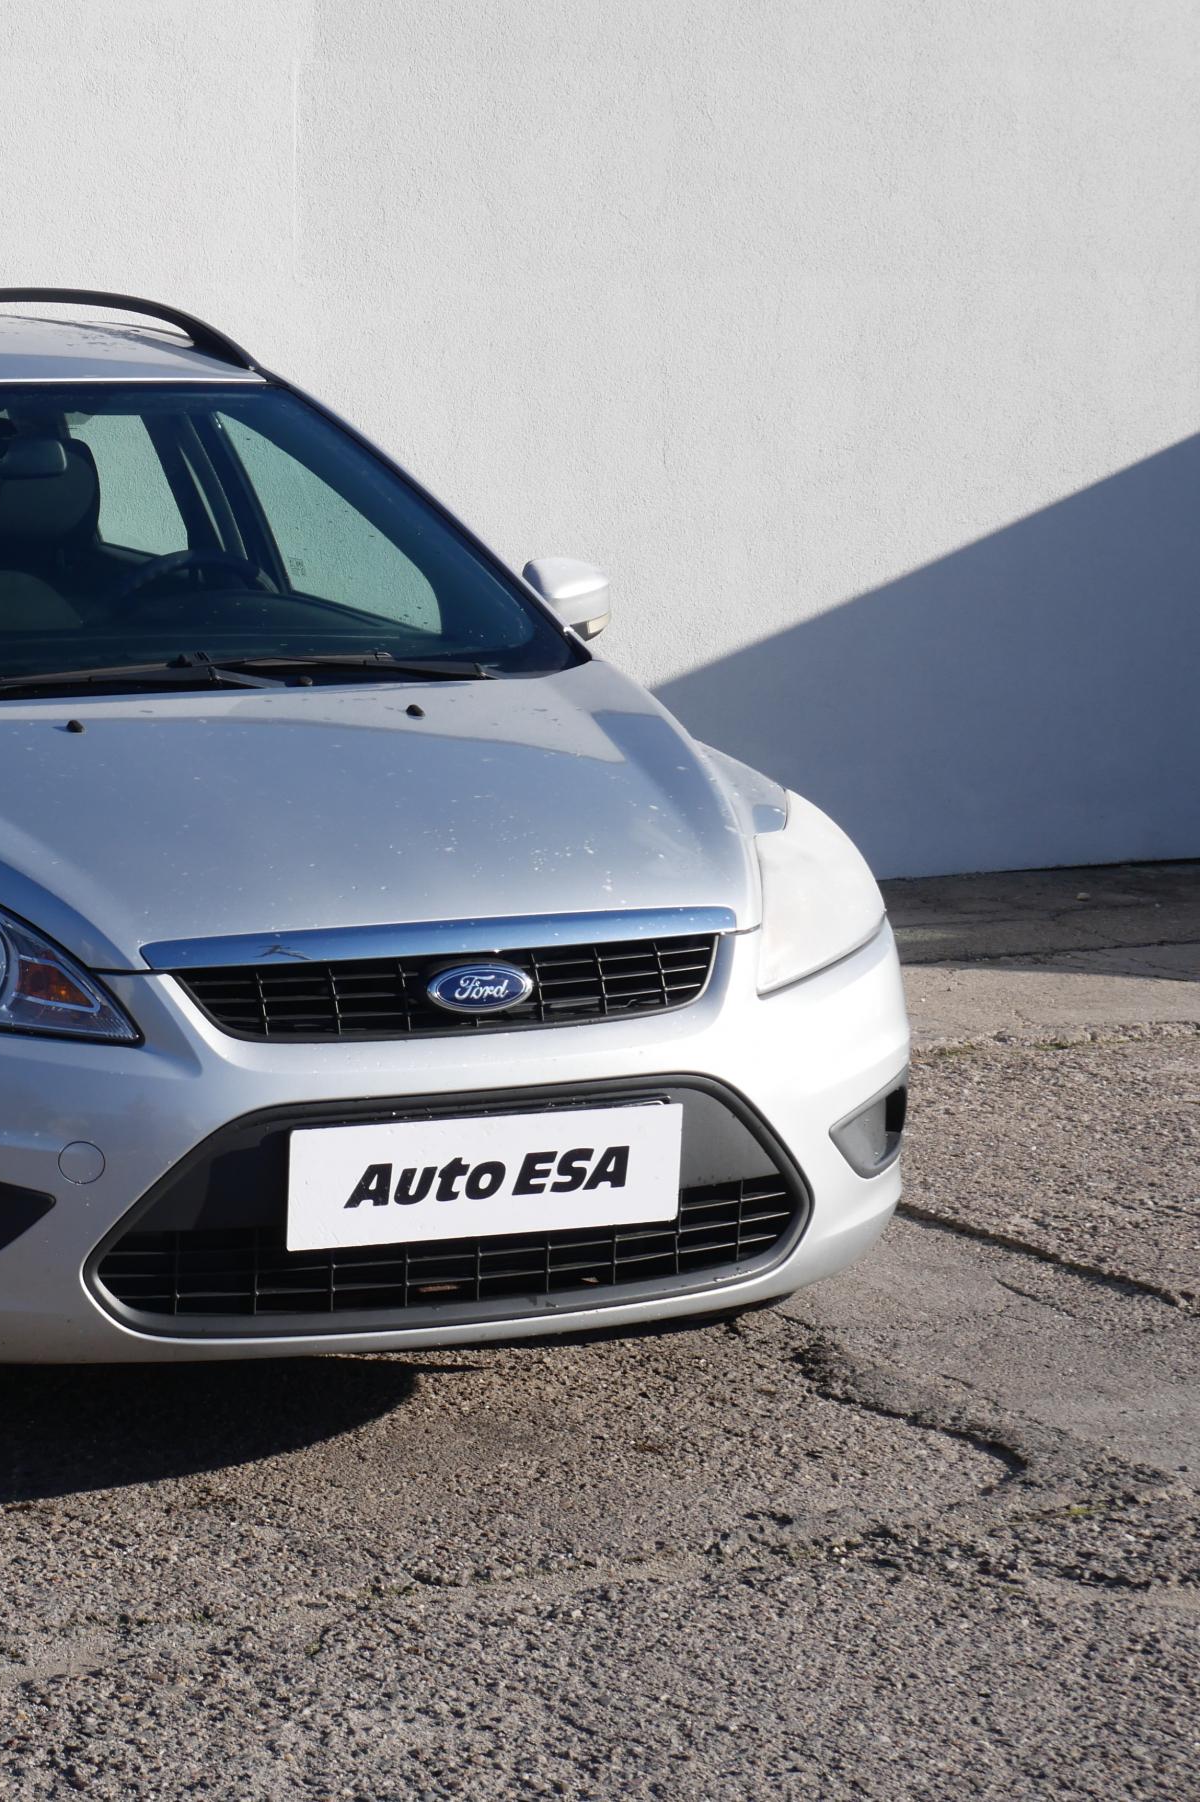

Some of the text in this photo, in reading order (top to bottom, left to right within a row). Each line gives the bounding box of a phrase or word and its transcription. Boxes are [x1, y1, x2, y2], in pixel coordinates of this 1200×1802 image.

[454, 975, 509, 1000] Ford
[343, 1145, 630, 1209] Auto ESA
